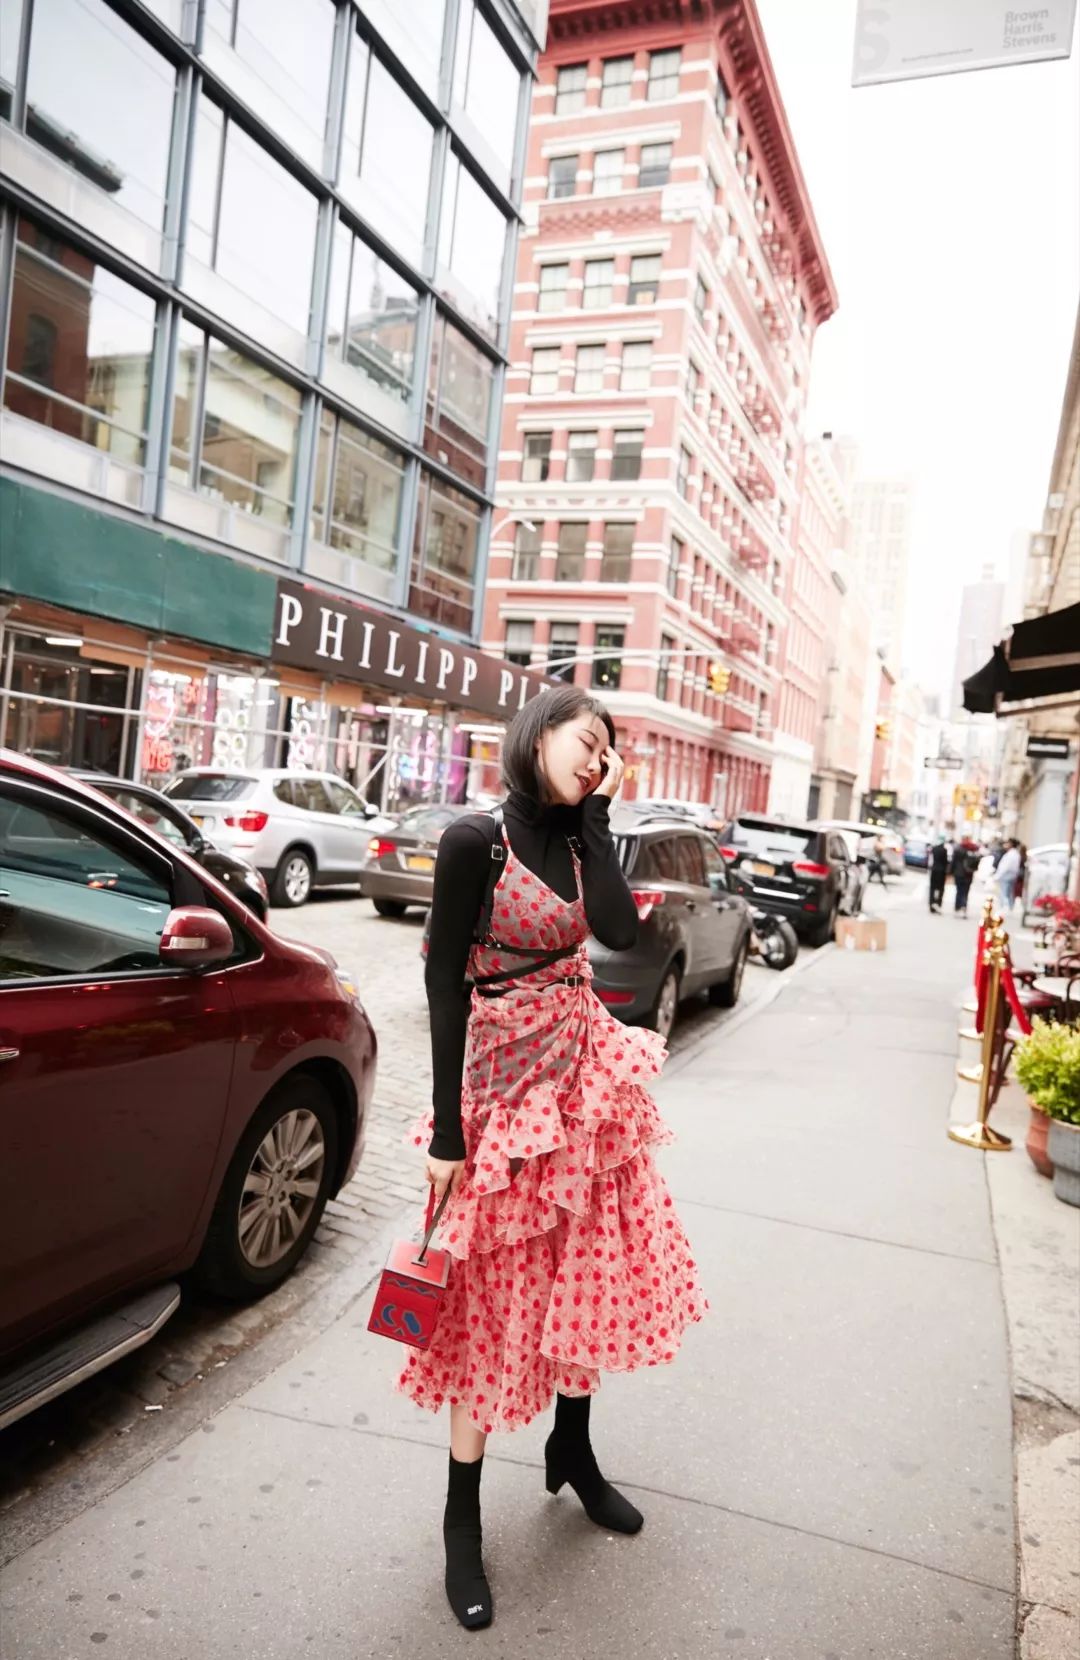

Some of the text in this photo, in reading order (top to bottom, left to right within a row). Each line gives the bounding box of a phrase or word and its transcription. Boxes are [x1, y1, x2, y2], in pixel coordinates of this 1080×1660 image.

[1005, 9, 1049, 23] Brown
[1004, 20, 1044, 35] Harris
[1002, 32, 1056, 48] Stevens
[275, 593, 478, 696] PHILIPP
